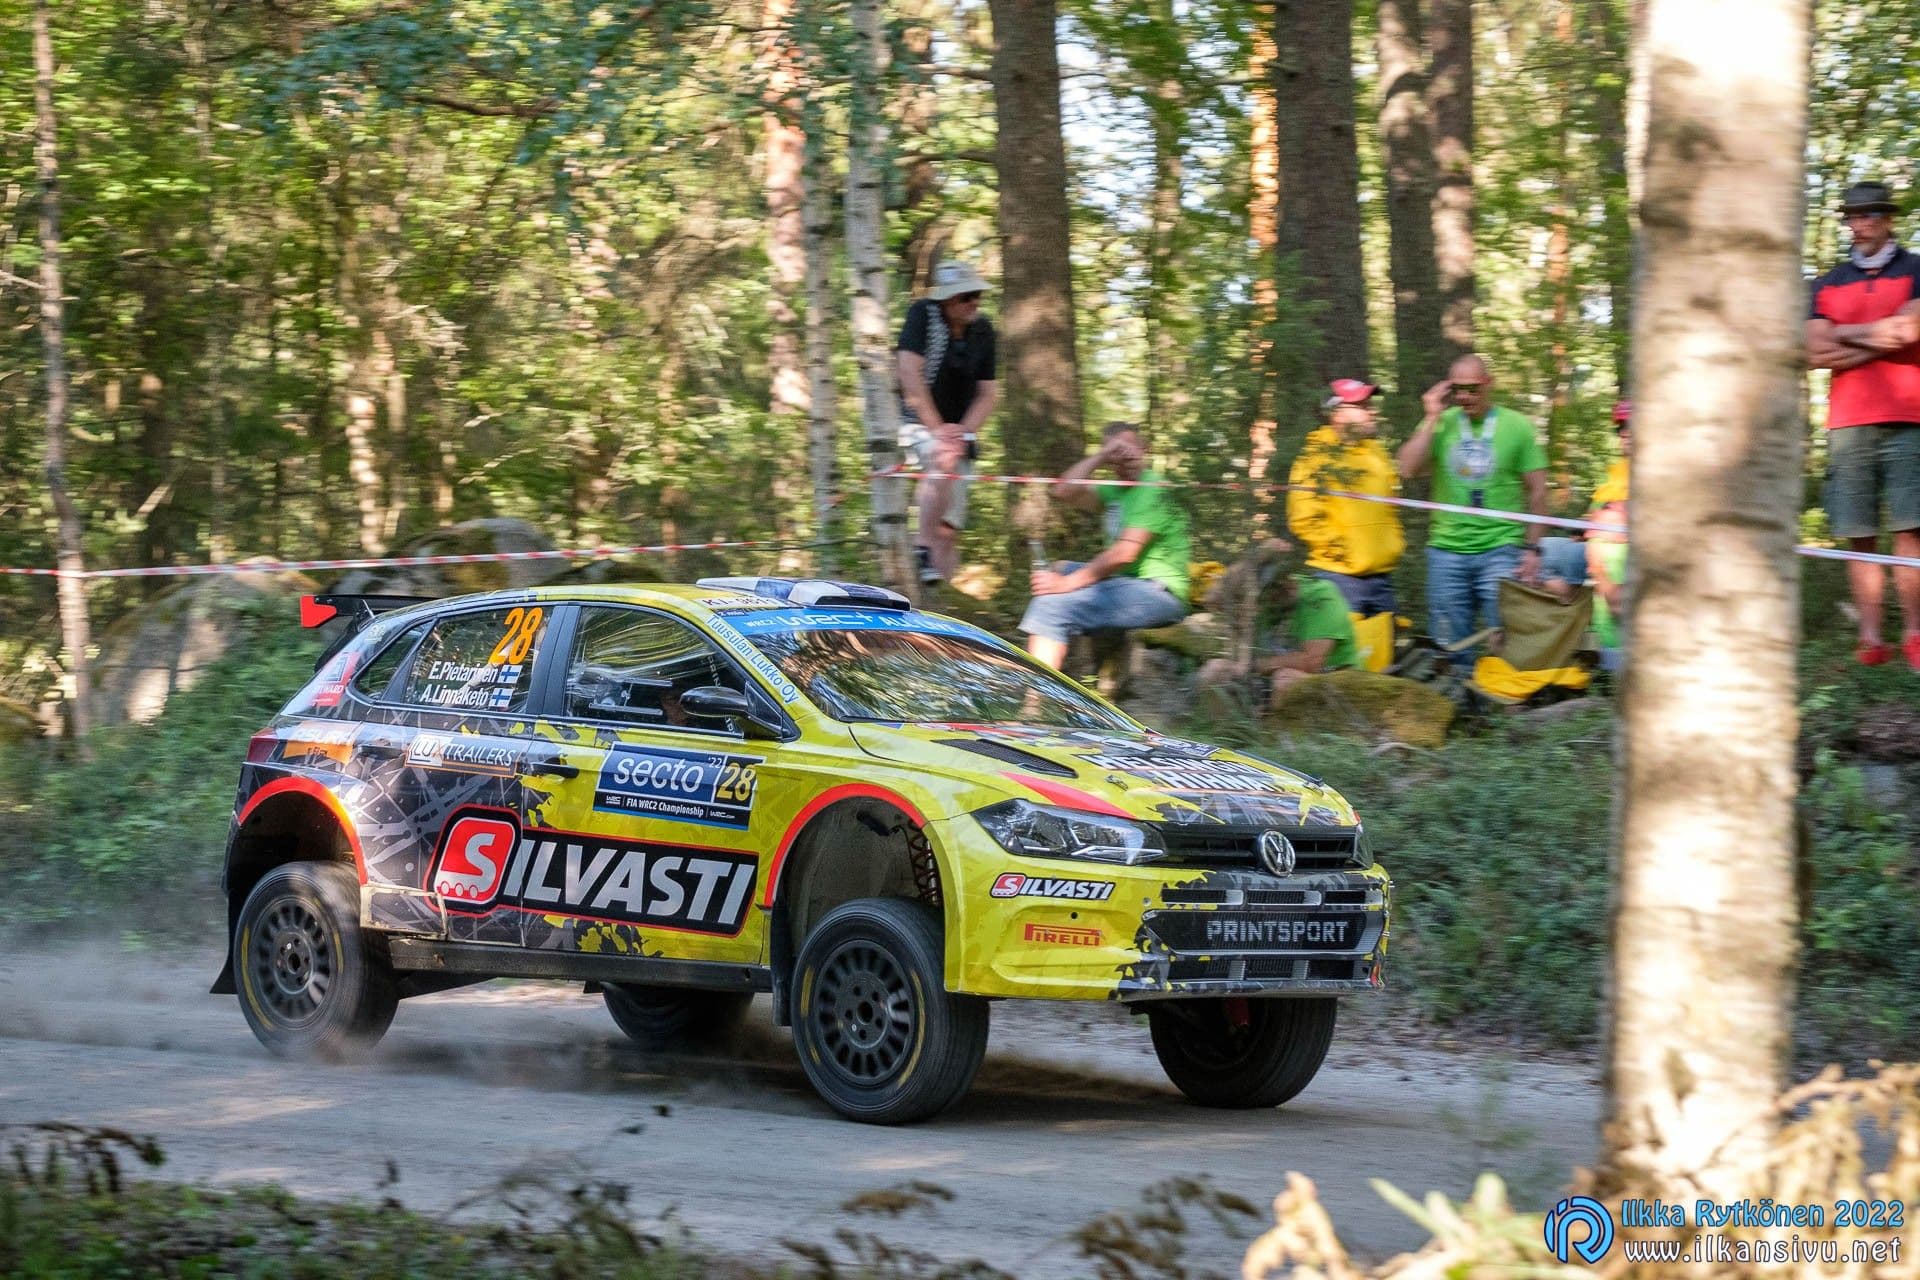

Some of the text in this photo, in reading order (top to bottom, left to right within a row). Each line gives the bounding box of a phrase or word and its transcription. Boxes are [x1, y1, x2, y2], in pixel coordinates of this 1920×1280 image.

[488, 607, 543, 664] 28
[704, 614, 799, 704] Tuusulan Lukko Oy
[420, 684, 489, 706] A.Linnaketo
[445, 744, 516, 766] TRAILERS
[613, 757, 704, 793] secto
[716, 762, 757, 801] 28
[626, 798, 704, 818] FIA WRC2 Championship
[434, 833, 756, 926] SILVASTI
[994, 876, 1114, 899] SILVASTI
[1024, 923, 1101, 947] PIRELLI
[1208, 921, 1348, 942] PRINTSPORT
